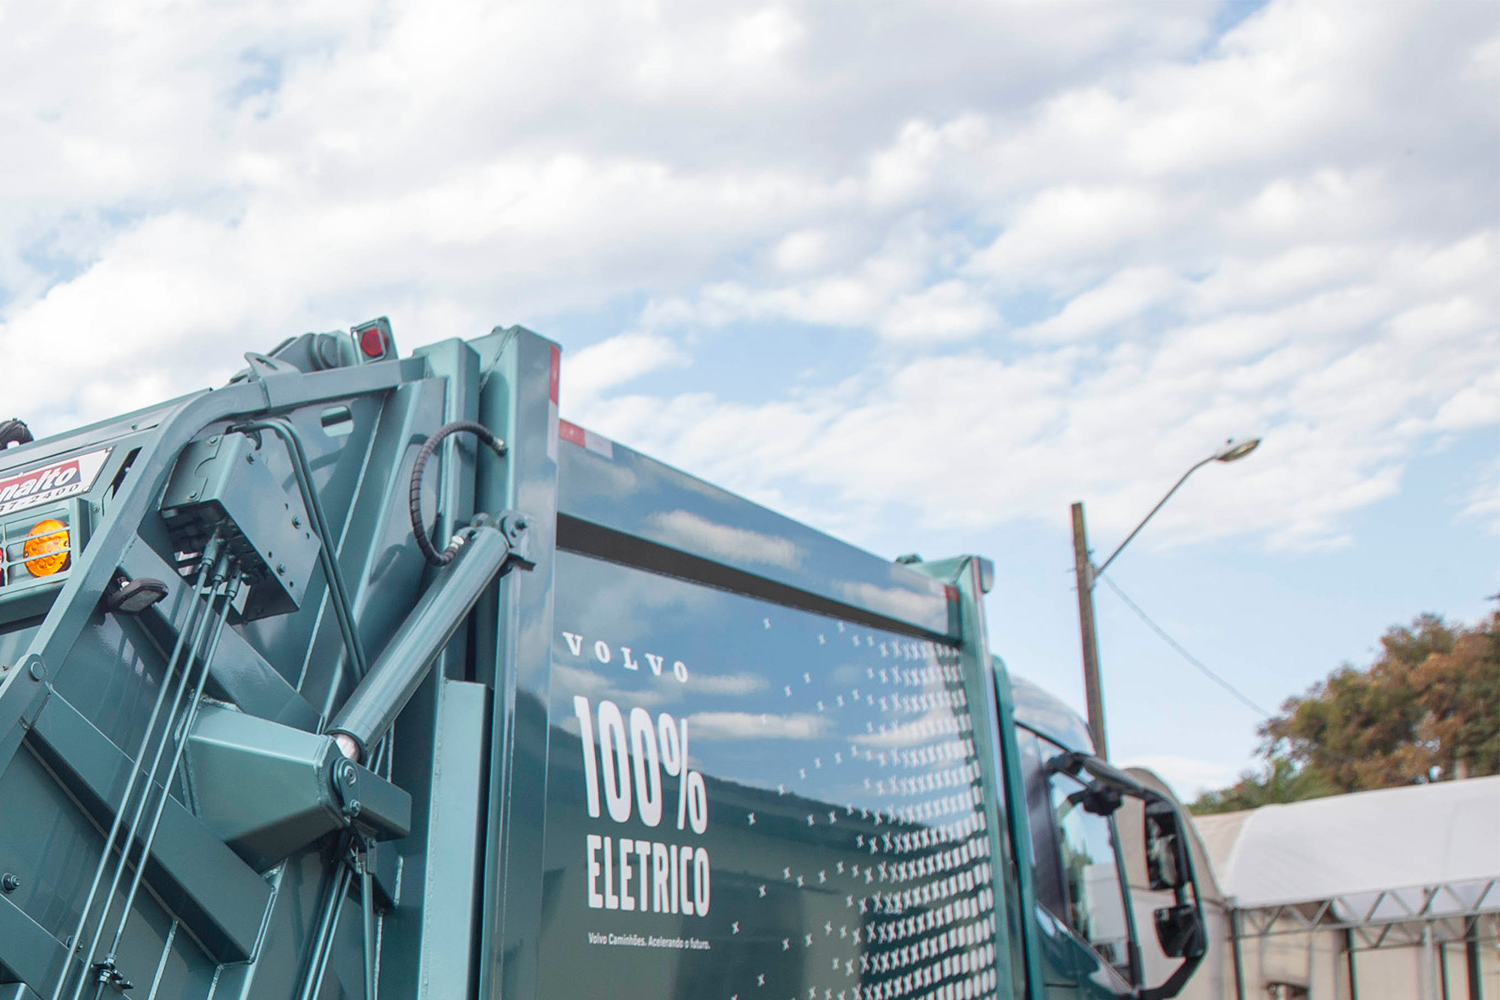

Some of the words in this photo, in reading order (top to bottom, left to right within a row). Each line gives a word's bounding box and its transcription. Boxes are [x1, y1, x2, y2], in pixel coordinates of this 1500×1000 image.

[562, 631, 688, 683] VOLVO
[573, 695, 708, 834] 100%
[587, 834, 710, 917] ELETRICO
[588, 931, 608, 945] Volvo
[608, 933, 647, 947] Caminhões.
[648, 935, 684, 949] Acelerando
[689, 937, 711, 950] futuro.
